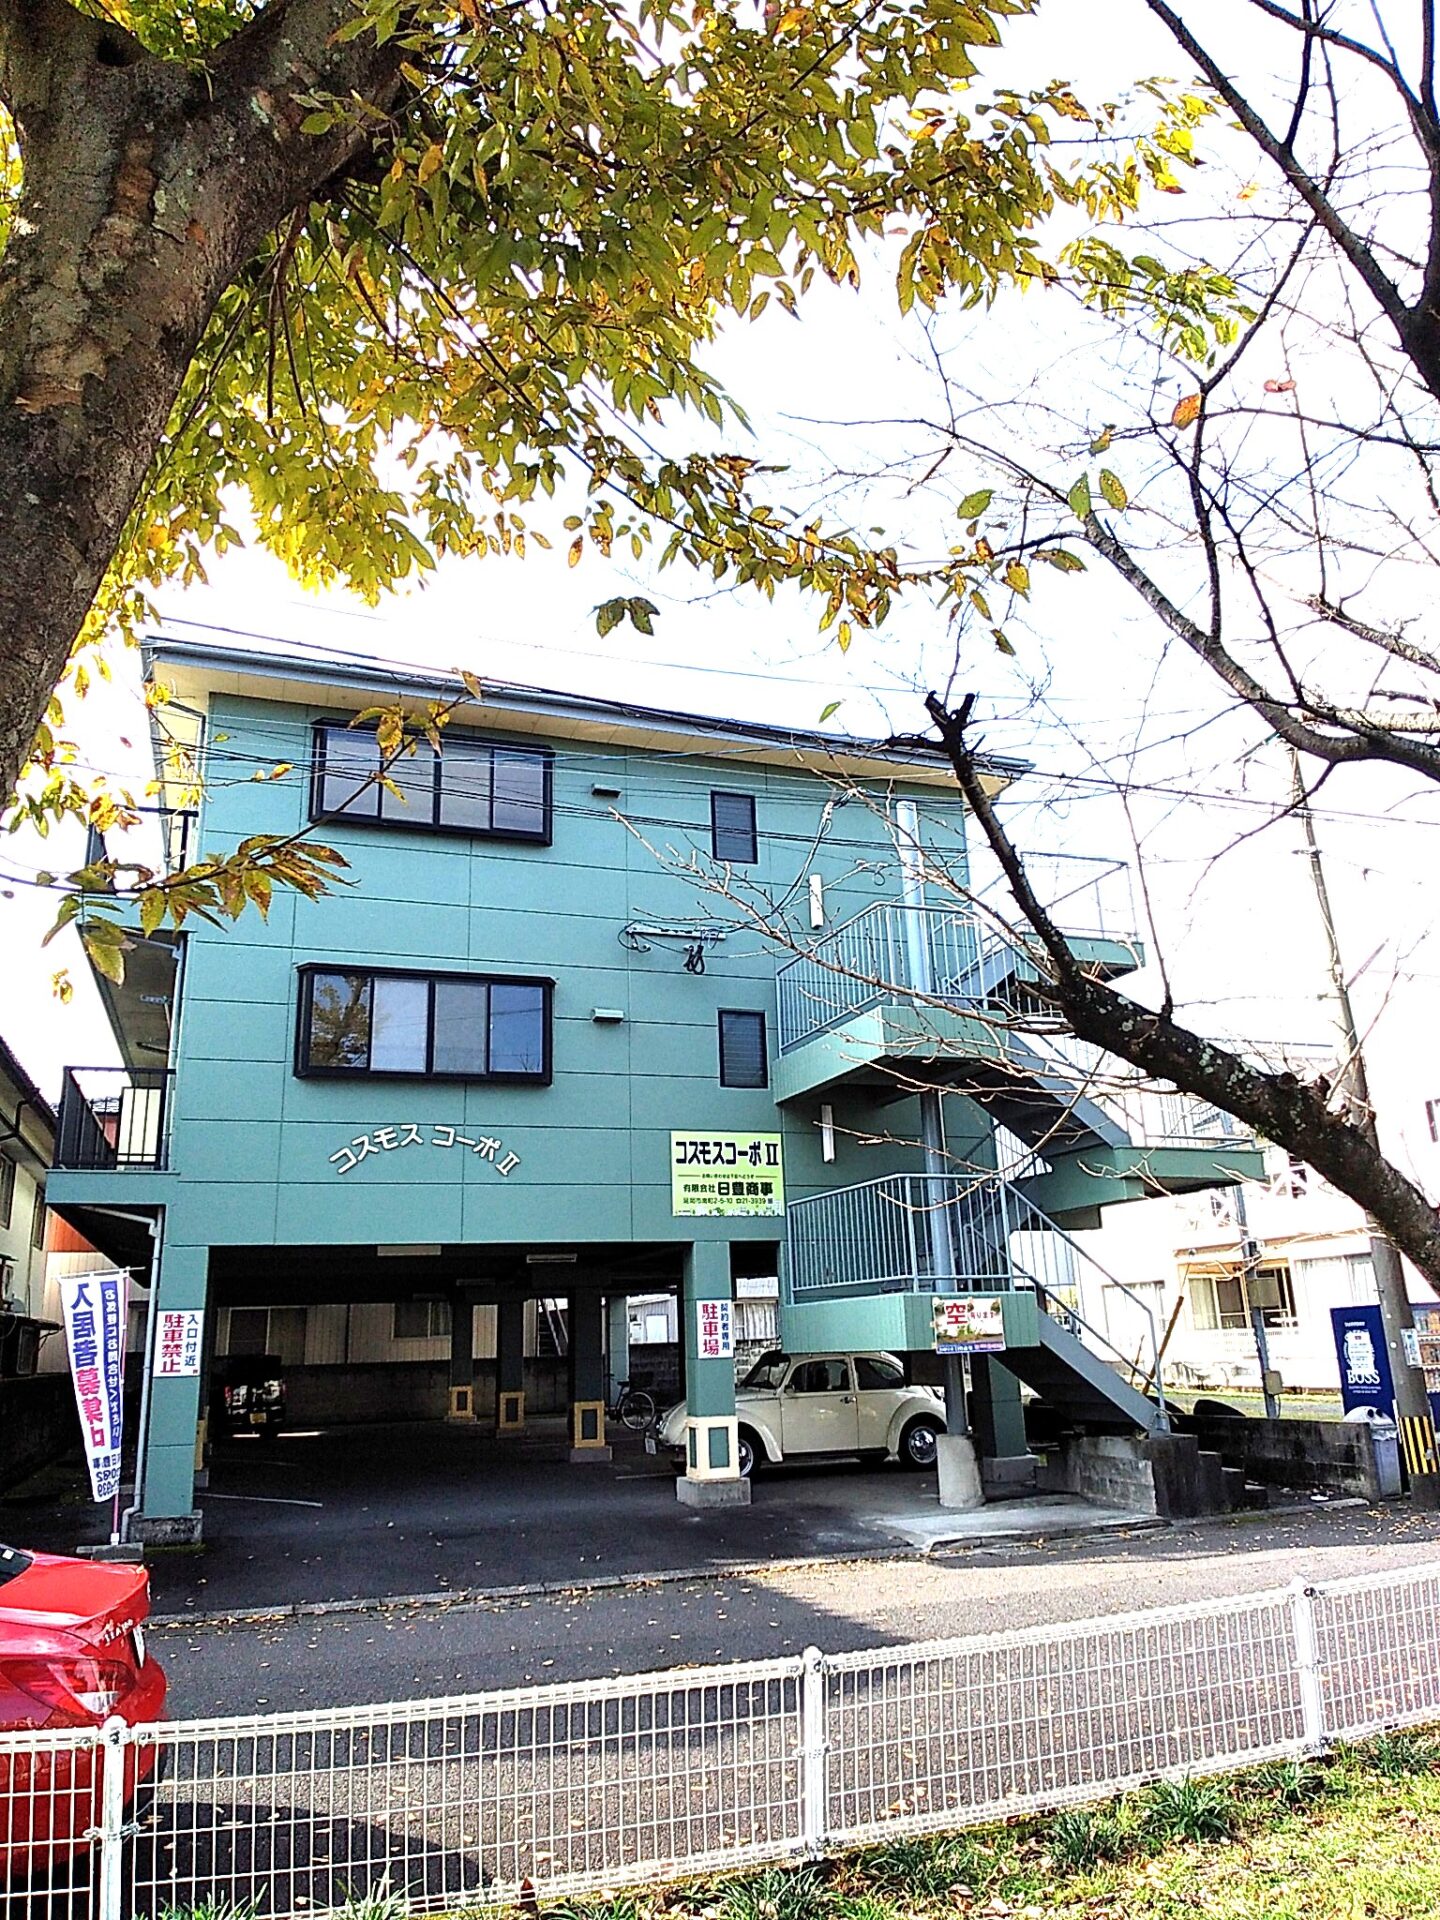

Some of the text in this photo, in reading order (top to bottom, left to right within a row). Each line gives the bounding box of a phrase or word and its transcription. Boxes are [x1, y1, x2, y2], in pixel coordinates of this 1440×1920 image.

[329, 1123, 424, 1174] コスモス
[160, 1314, 185, 1373] 駐車禁止
[184, 1314, 199, 1367] 入口付近
[702, 1303, 719, 1355] 駐車場
